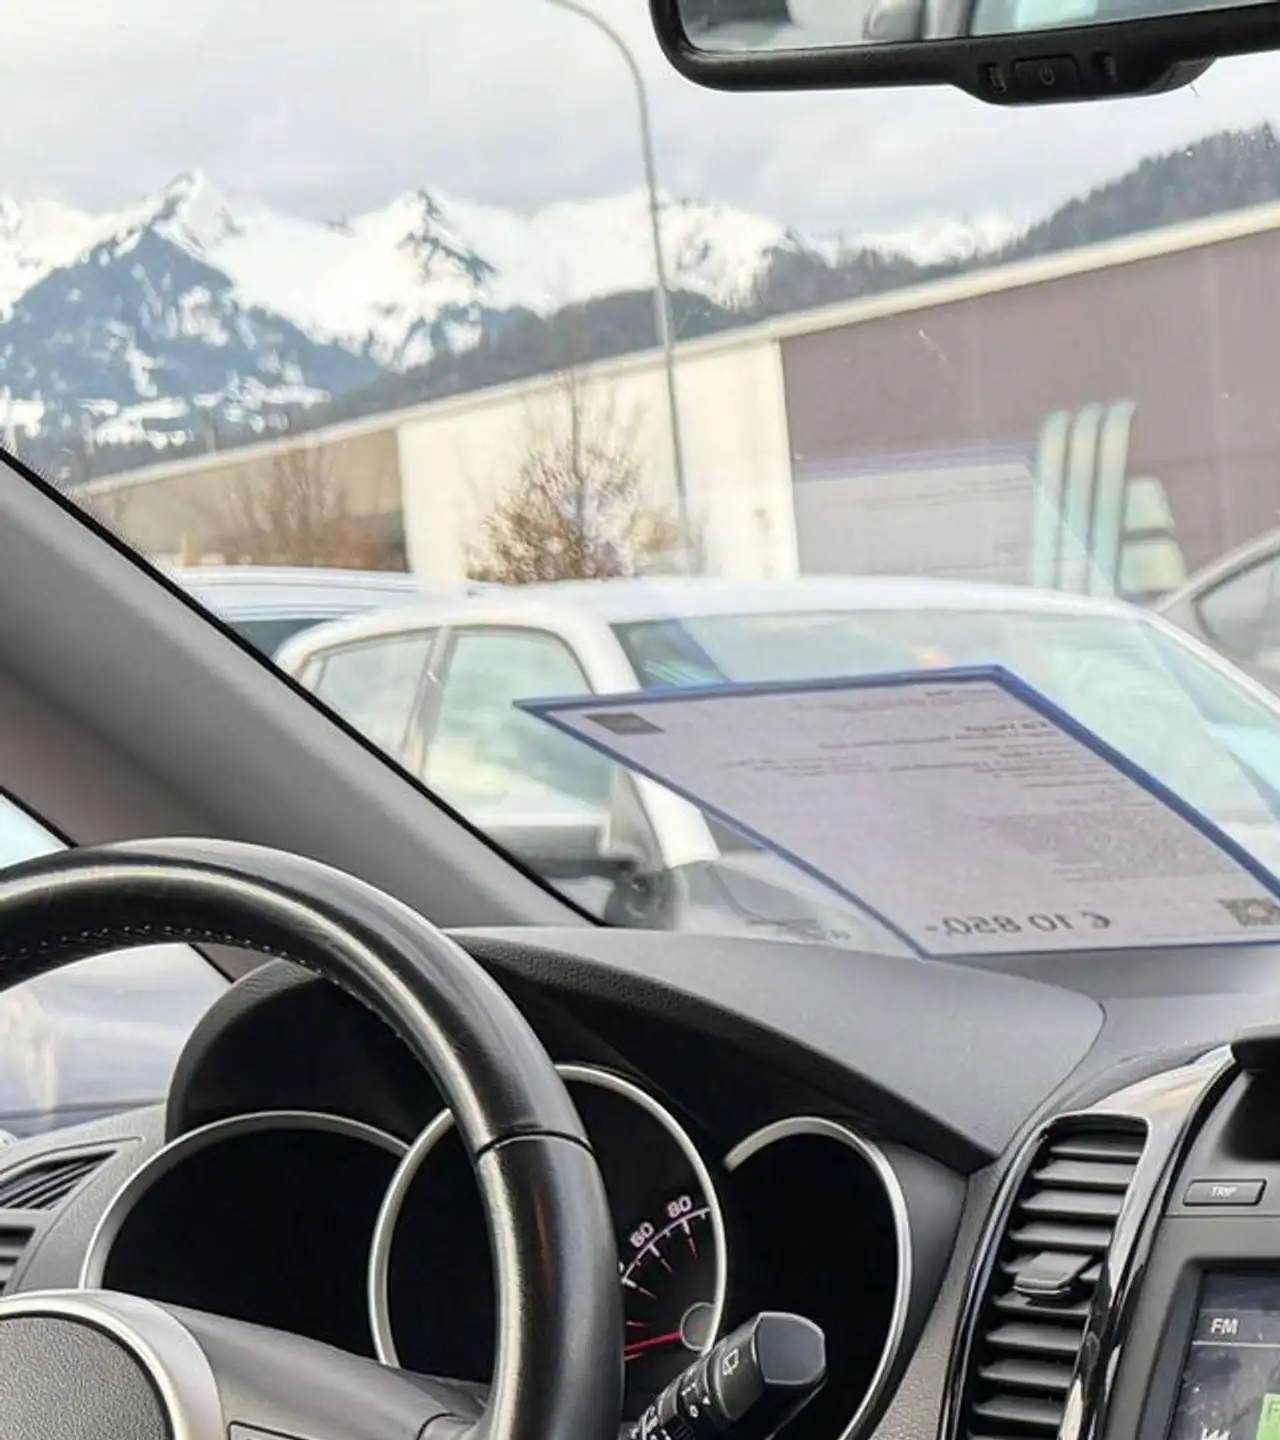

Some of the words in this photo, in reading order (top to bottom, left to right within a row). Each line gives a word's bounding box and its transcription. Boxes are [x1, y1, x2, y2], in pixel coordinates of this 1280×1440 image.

[1210, 1186, 1237, 1197] TRIP
[666, 1195, 692, 1219] 80
[629, 1221, 655, 1248] 60
[1211, 1318, 1238, 1335] FM
